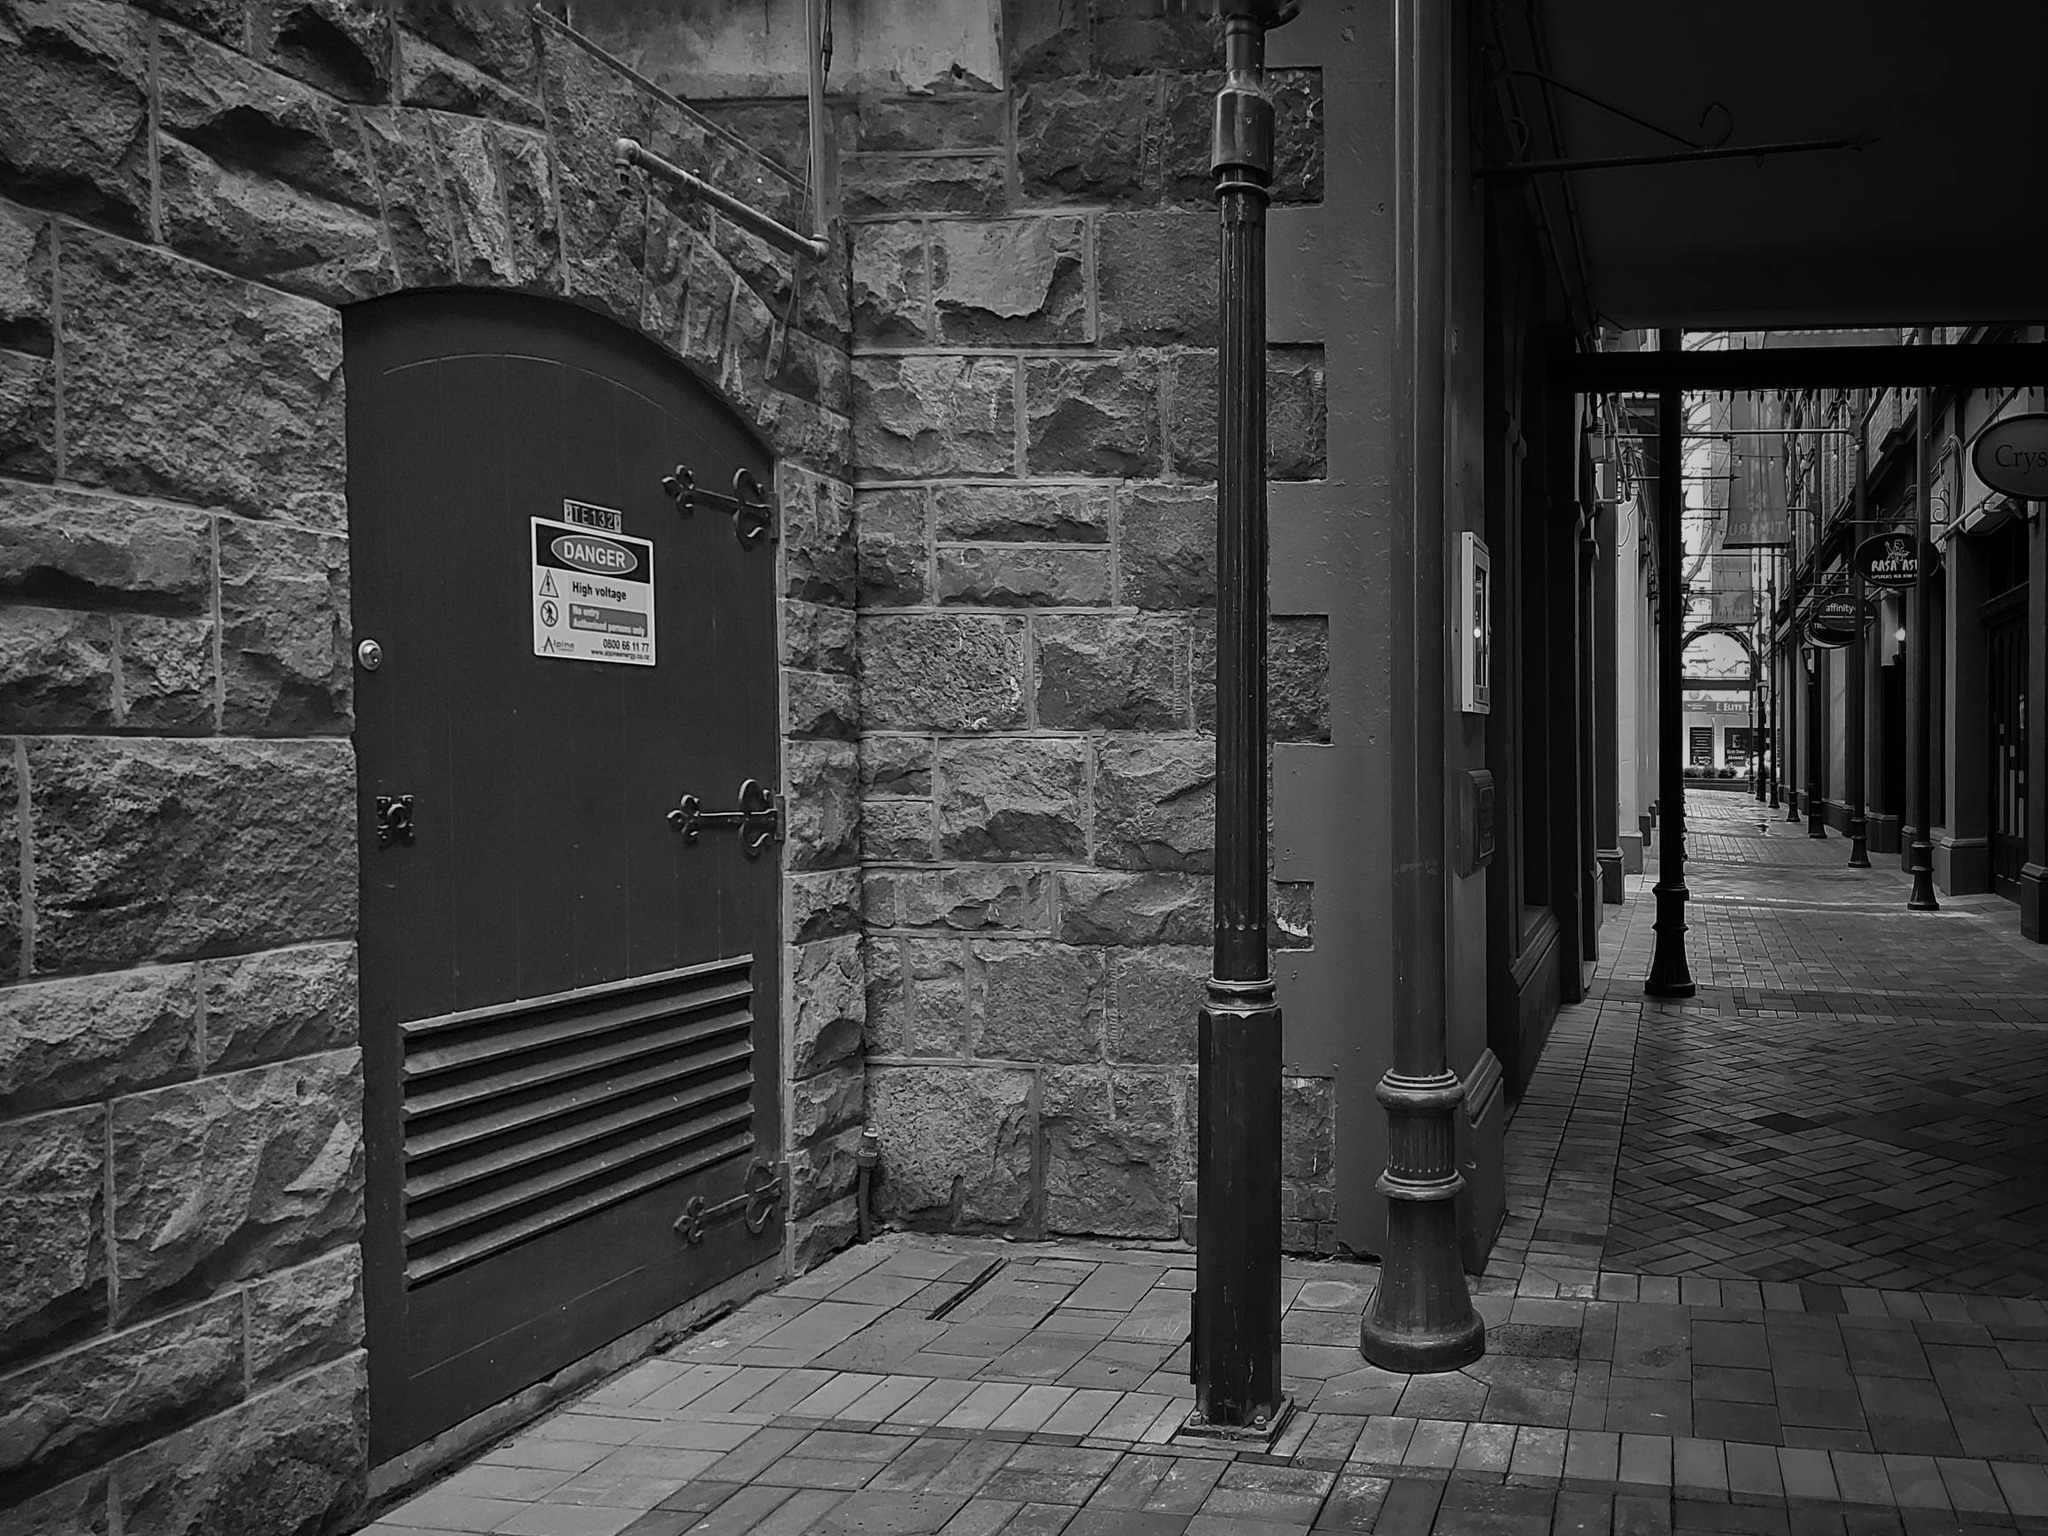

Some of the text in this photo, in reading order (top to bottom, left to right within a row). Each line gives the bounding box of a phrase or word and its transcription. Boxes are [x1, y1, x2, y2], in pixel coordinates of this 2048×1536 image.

[563, 541, 626, 568] DANGER
[1871, 558, 1918, 572] RASA ASI
[572, 581, 627, 602] High voltage
[572, 605, 582, 616] No
[541, 636, 575, 653] Alpine
[603, 639, 650, 652] 0800 66 11 77
